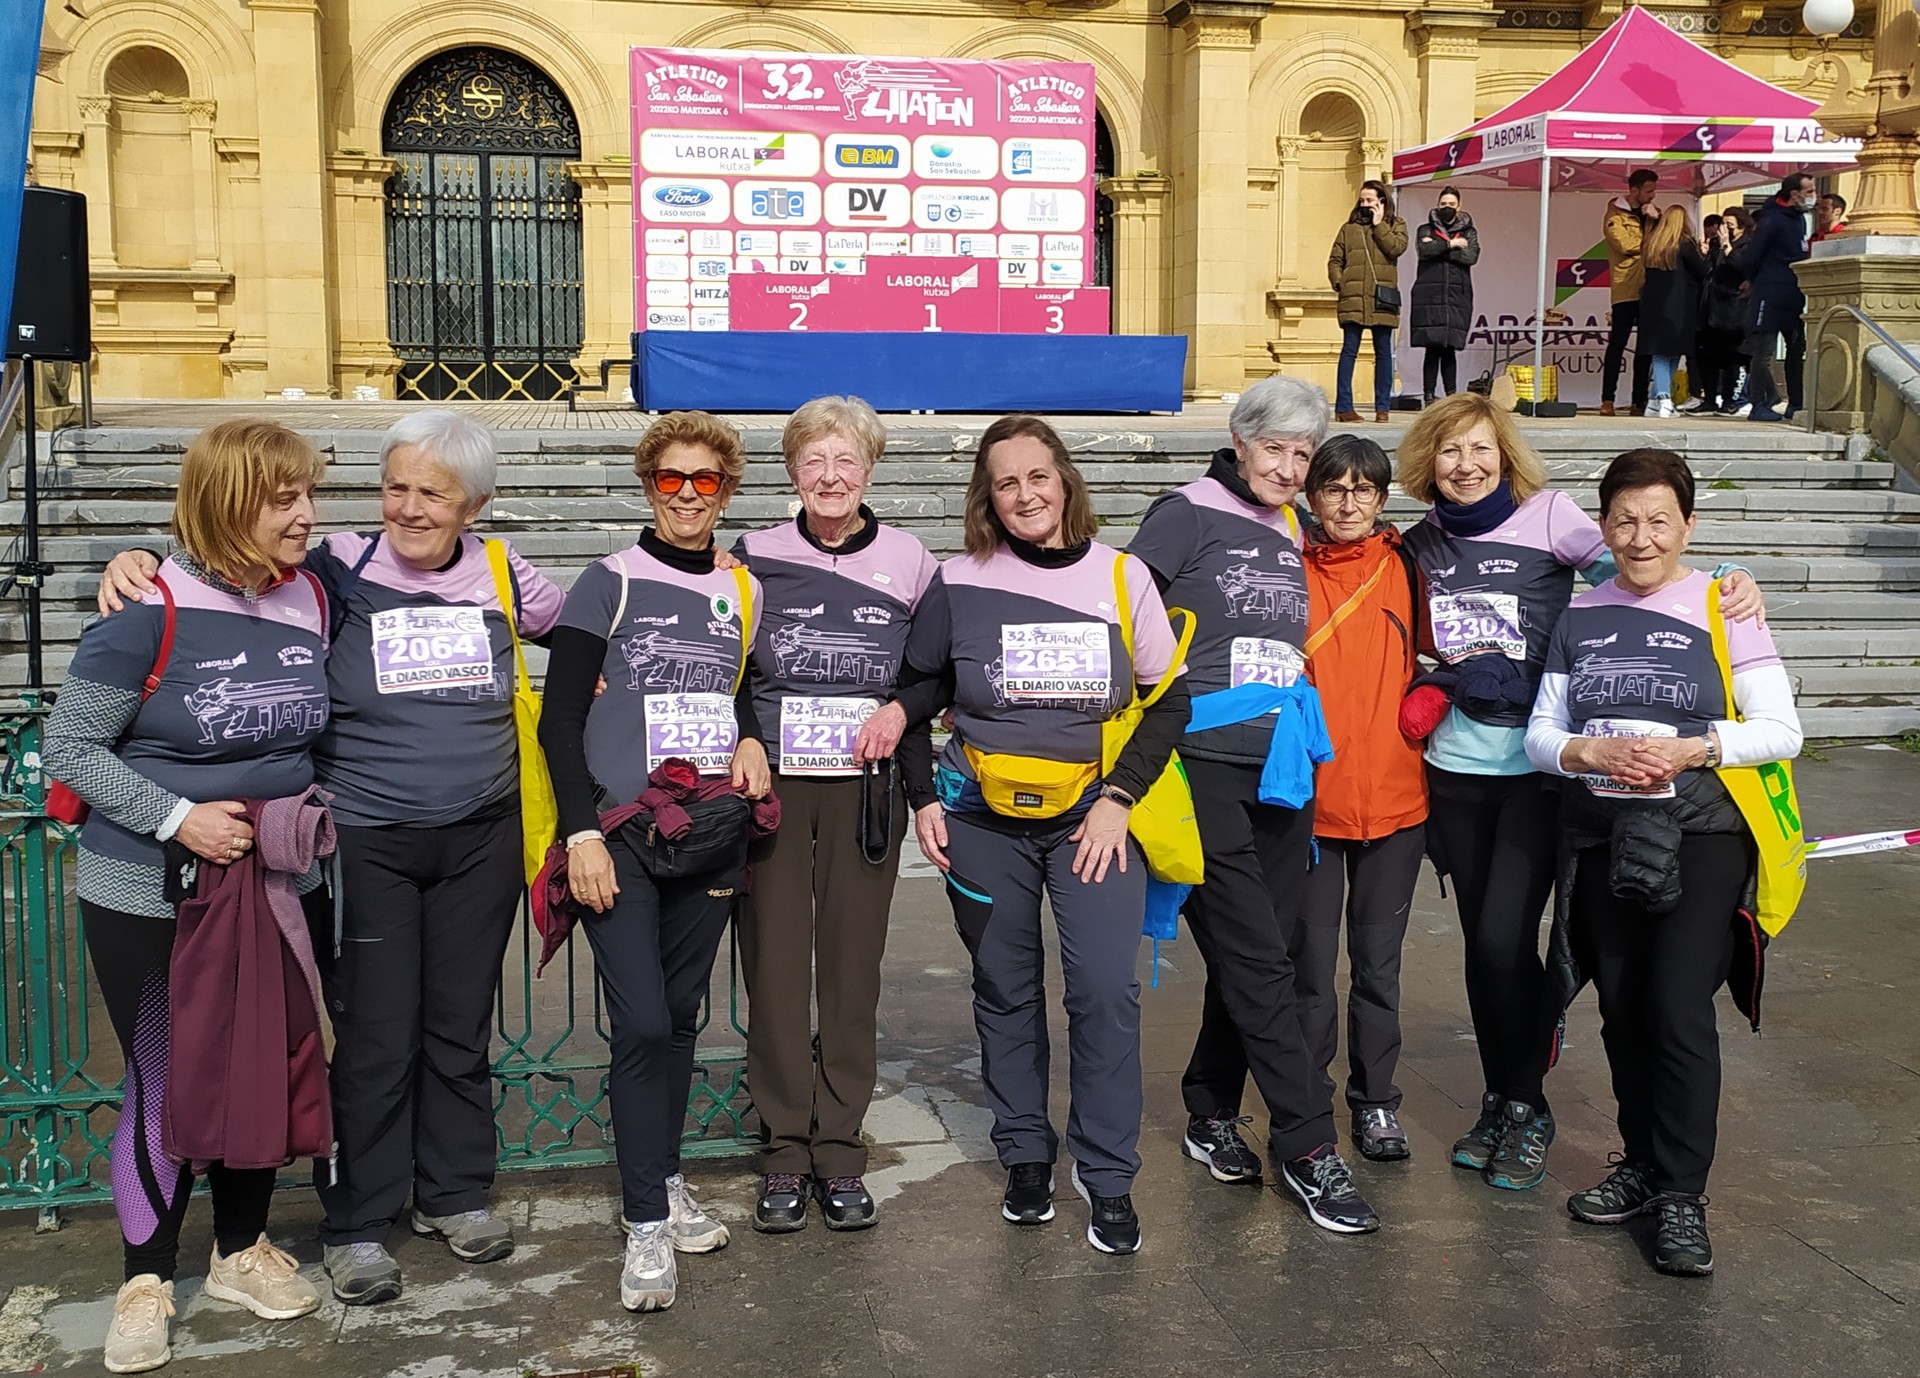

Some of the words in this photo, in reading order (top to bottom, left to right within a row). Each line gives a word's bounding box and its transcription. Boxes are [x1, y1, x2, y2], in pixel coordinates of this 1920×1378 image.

[645, 64, 729, 91] ATLETICO
[648, 85, 671, 102] San
[673, 86, 724, 103] Sebastian
[1007, 76, 1086, 101] ATLETICO
[1009, 96, 1031, 113] San
[1034, 96, 1082, 114] Sebastian
[1486, 122, 1537, 150] LABORAL
[675, 145, 750, 161] LABORAL
[862, 148, 895, 166] BM
[720, 161, 751, 173] kutxa
[929, 161, 962, 169] Donostia
[665, 187, 701, 205] Ford
[754, 189, 805, 218] ate
[849, 187, 888, 212] DV
[660, 209, 679, 217] EASO
[699, 261, 727, 276] ate
[790, 260, 809, 272] DV
[1008, 262, 1027, 274] DV
[886, 275, 950, 288] LABORAL
[765, 285, 811, 295] LABORAL
[923, 288, 950, 297] kutxa
[788, 303, 809, 331] 2
[922, 304, 943, 333] 1
[1045, 306, 1064, 334] 3
[1477, 559, 1520, 570] ATLETICO
[634, 616, 666, 624] LABORAL
[853, 606, 892, 620] ATLETICO
[707, 621, 741, 637] ATLETICO
[1486, 640, 1523, 653] VASCO
[1646, 632, 1693, 645] ATLETICO
[277, 645, 314, 662] ATLETICO
[387, 635, 479, 665] 2064
[195, 659, 233, 670] LABORAL
[1015, 649, 1096, 673] 2651
[379, 675, 395, 686] EL
[396, 669, 442, 684] DIARIO
[444, 664, 489, 679] VASCO
[1006, 680, 1021, 691] EL
[1022, 680, 1065, 691] DIARIO
[1066, 680, 1108, 691] VASCO
[659, 722, 733, 751] 2525
[782, 756, 797, 767] EL
[798, 757, 840, 767] DIARIO
